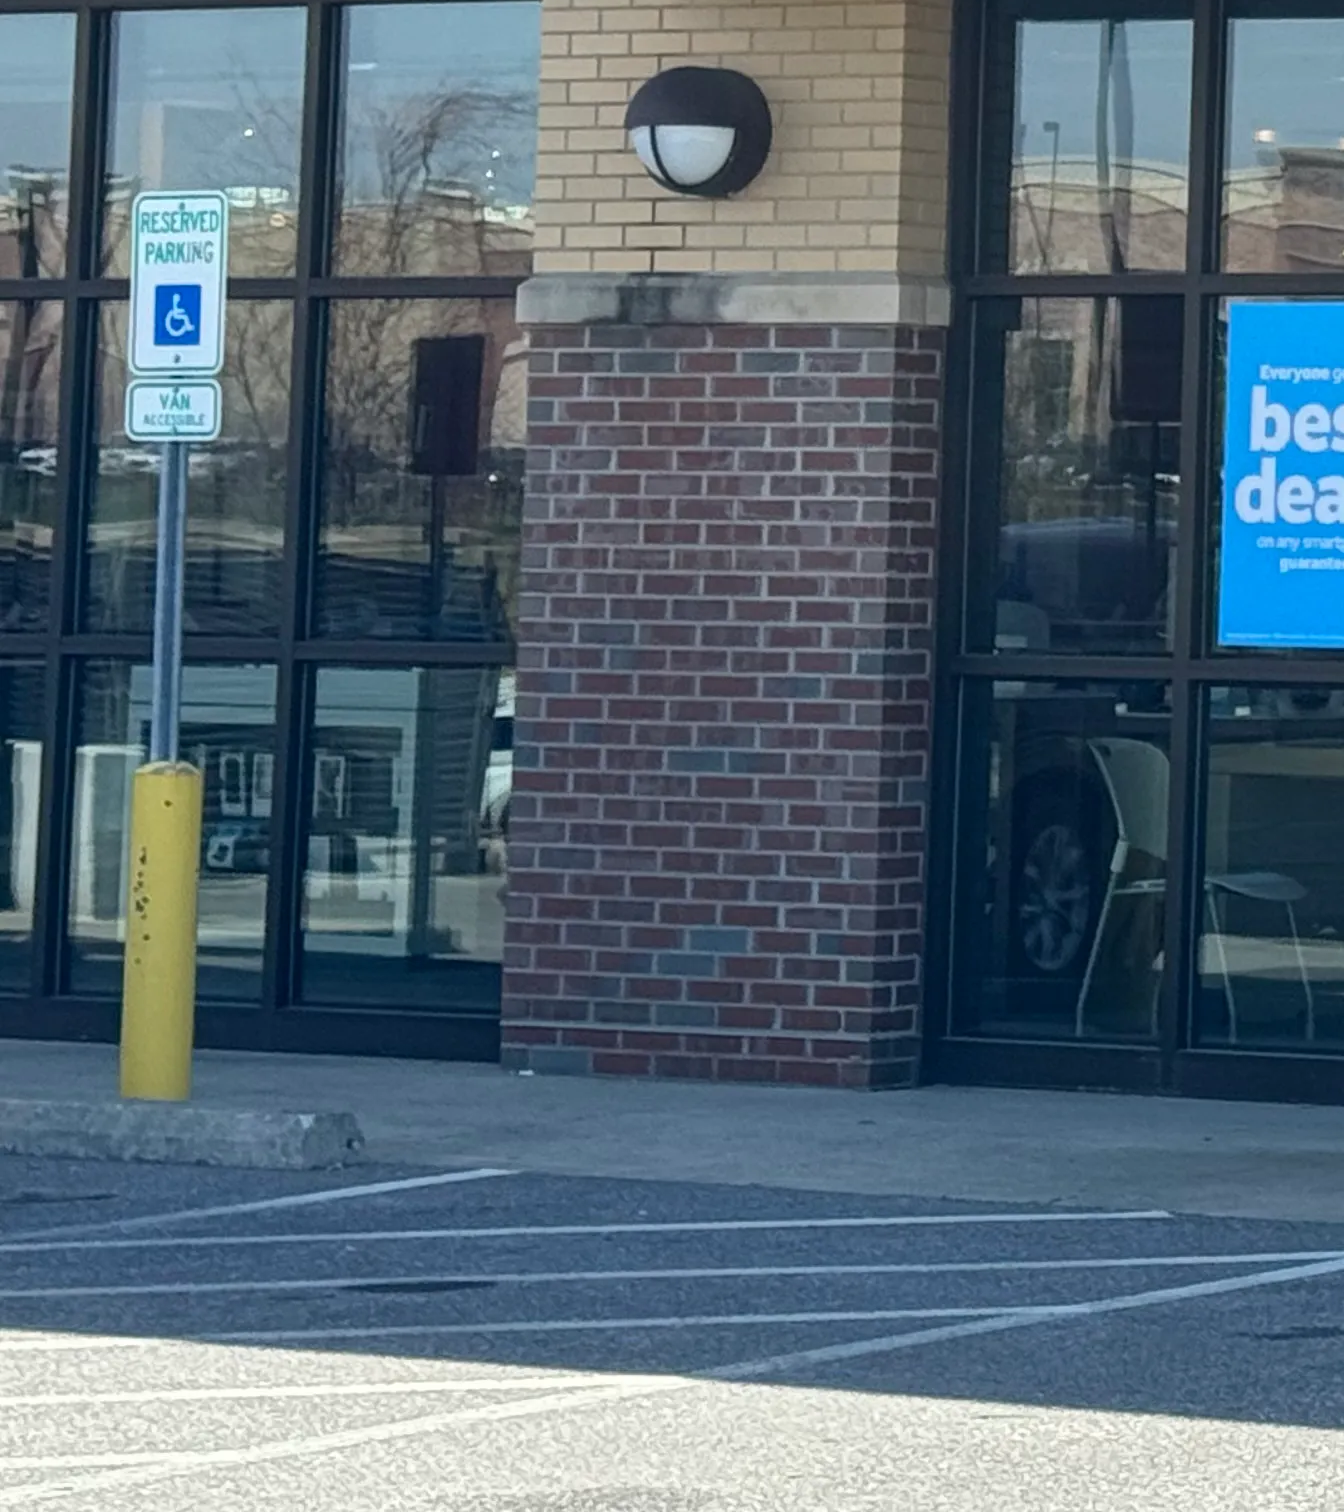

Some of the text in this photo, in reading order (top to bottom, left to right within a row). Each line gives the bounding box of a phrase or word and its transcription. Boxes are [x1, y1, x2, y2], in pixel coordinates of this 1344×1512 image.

[139, 210, 220, 234] RESERVED
[145, 240, 214, 265] PARKING
[1259, 364, 1330, 385] Everyone
[159, 392, 190, 411] VAN
[143, 413, 206, 426] ACCESSIBLE
[1256, 536, 1275, 549] on
[1276, 537, 1300, 553] any
